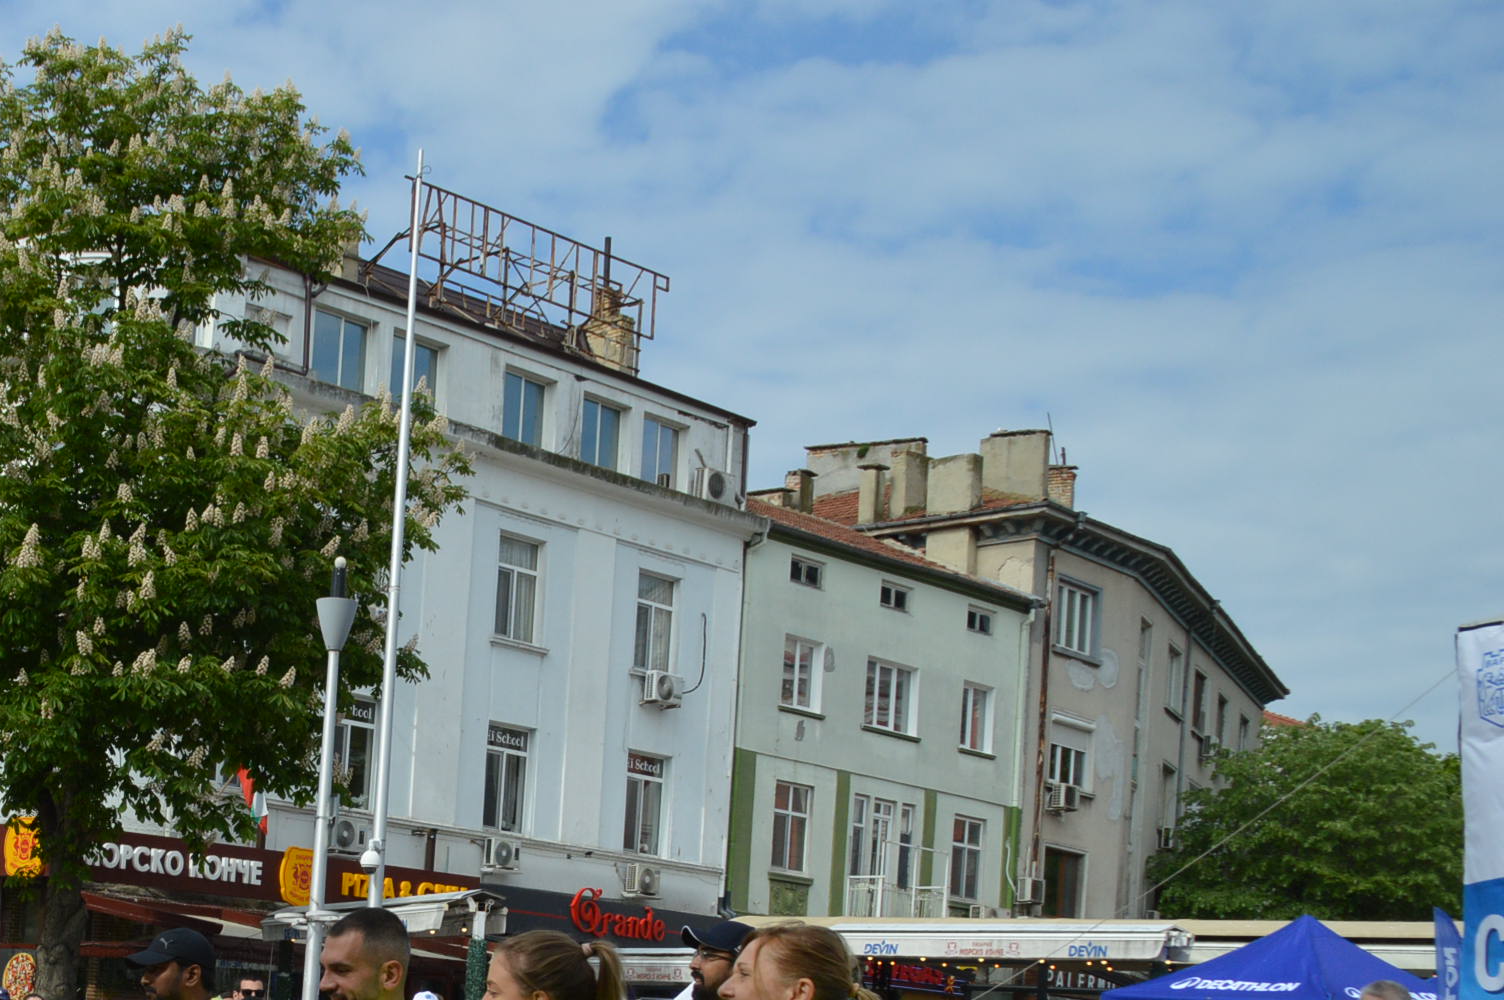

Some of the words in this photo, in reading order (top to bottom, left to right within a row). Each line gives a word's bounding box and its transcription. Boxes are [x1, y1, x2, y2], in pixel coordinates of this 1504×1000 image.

[341, 872, 395, 899] PIZA
[570, 887, 666, 942] Grande
[864, 940, 898, 955] DEVIN
[1068, 942, 1108, 957] DEVIN
[1197, 979, 1300, 992] DECATHLON
